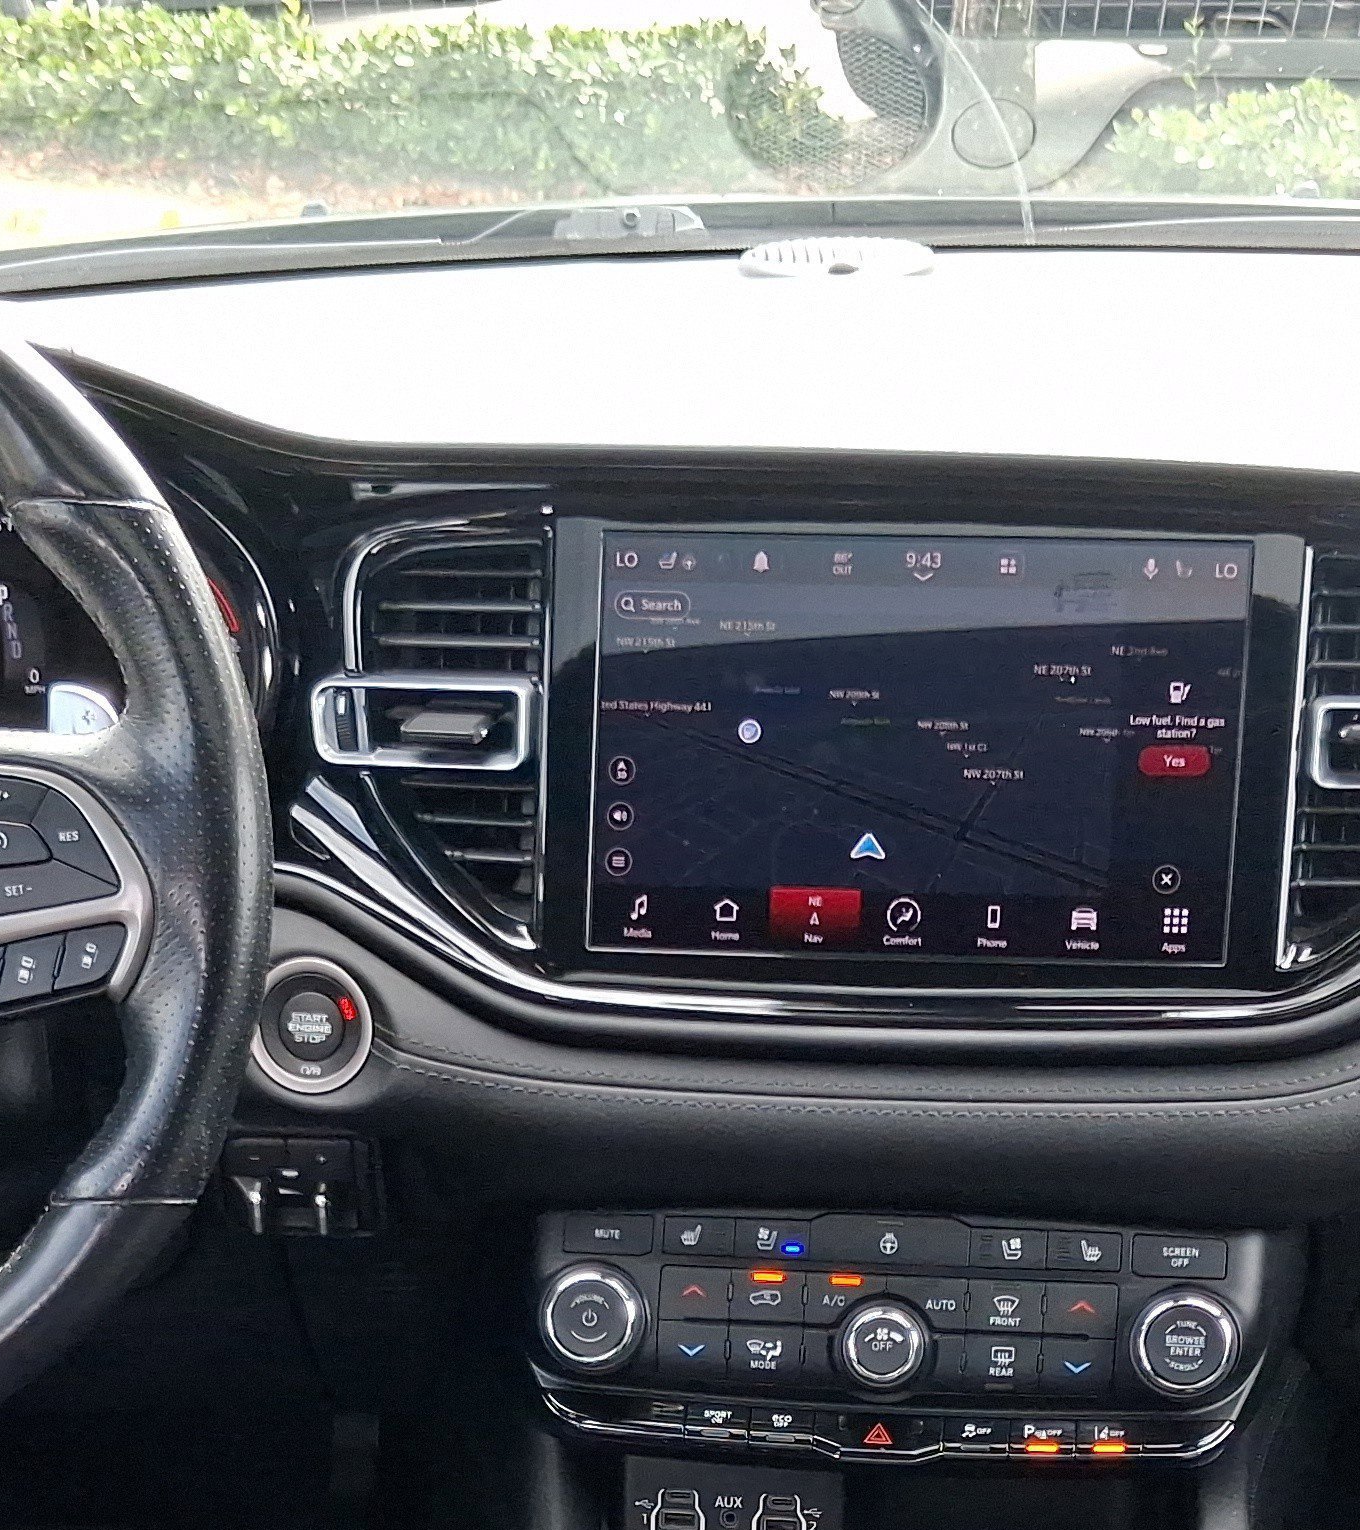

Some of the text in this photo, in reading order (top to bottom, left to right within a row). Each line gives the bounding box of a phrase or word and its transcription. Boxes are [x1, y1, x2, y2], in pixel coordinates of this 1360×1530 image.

[616, 551, 639, 568] LO
[905, 552, 942, 569] 9:43
[1214, 563, 1239, 579] LO
[640, 598, 683, 613] Search
[650, 701, 692, 714] Highway
[1129, 714, 1150, 727] Low
[1152, 714, 1173, 727] fuel.
[1175, 714, 1198, 728] Find
[1207, 718, 1226, 730] gas
[1156, 727, 1197, 739] station?
[1162, 754, 1187, 769] Yes
[963, 768, 981, 779] NW
[1013, 769, 1024, 780] St
[58, 830, 80, 843] RES
[623, 926, 652, 939] Media
[710, 930, 740, 942] Home
[803, 932, 824, 945] Nav
[882, 934, 923, 947] Comfort
[976, 937, 1008, 949] Phone
[1064, 939, 1100, 951] Vehicle
[1160, 941, 1187, 955] Apps
[290, 1011, 329, 1022] START
[287, 1021, 333, 1035] ENGINE
[293, 1033, 327, 1044] STOP
[594, 1228, 621, 1240] MUTE
[1162, 1246, 1199, 1258] SCREEN
[1170, 1257, 1190, 1268] OFF
[821, 1294, 846, 1307] A/C
[925, 1299, 957, 1311] AUTO
[989, 1316, 1021, 1327] FRONT
[1175, 1320, 1198, 1330] TUNE
[1165, 1334, 1206, 1346] BROWSE
[871, 1341, 894, 1352] OFF
[1169, 1346, 1202, 1357] ENTER
[749, 1359, 778, 1370] MODE
[1167, 1359, 1199, 1372] SCROLL
[988, 1367, 1015, 1377] REAR
[703, 1409, 733, 1420] SPORT
[976, 1427, 992, 1436] OFF
[1047, 1428, 1063, 1437] OFF
[1109, 1429, 1125, 1438] OFF
[714, 1495, 743, 1509] AUX
[641, 1512, 648, 1525] 1
